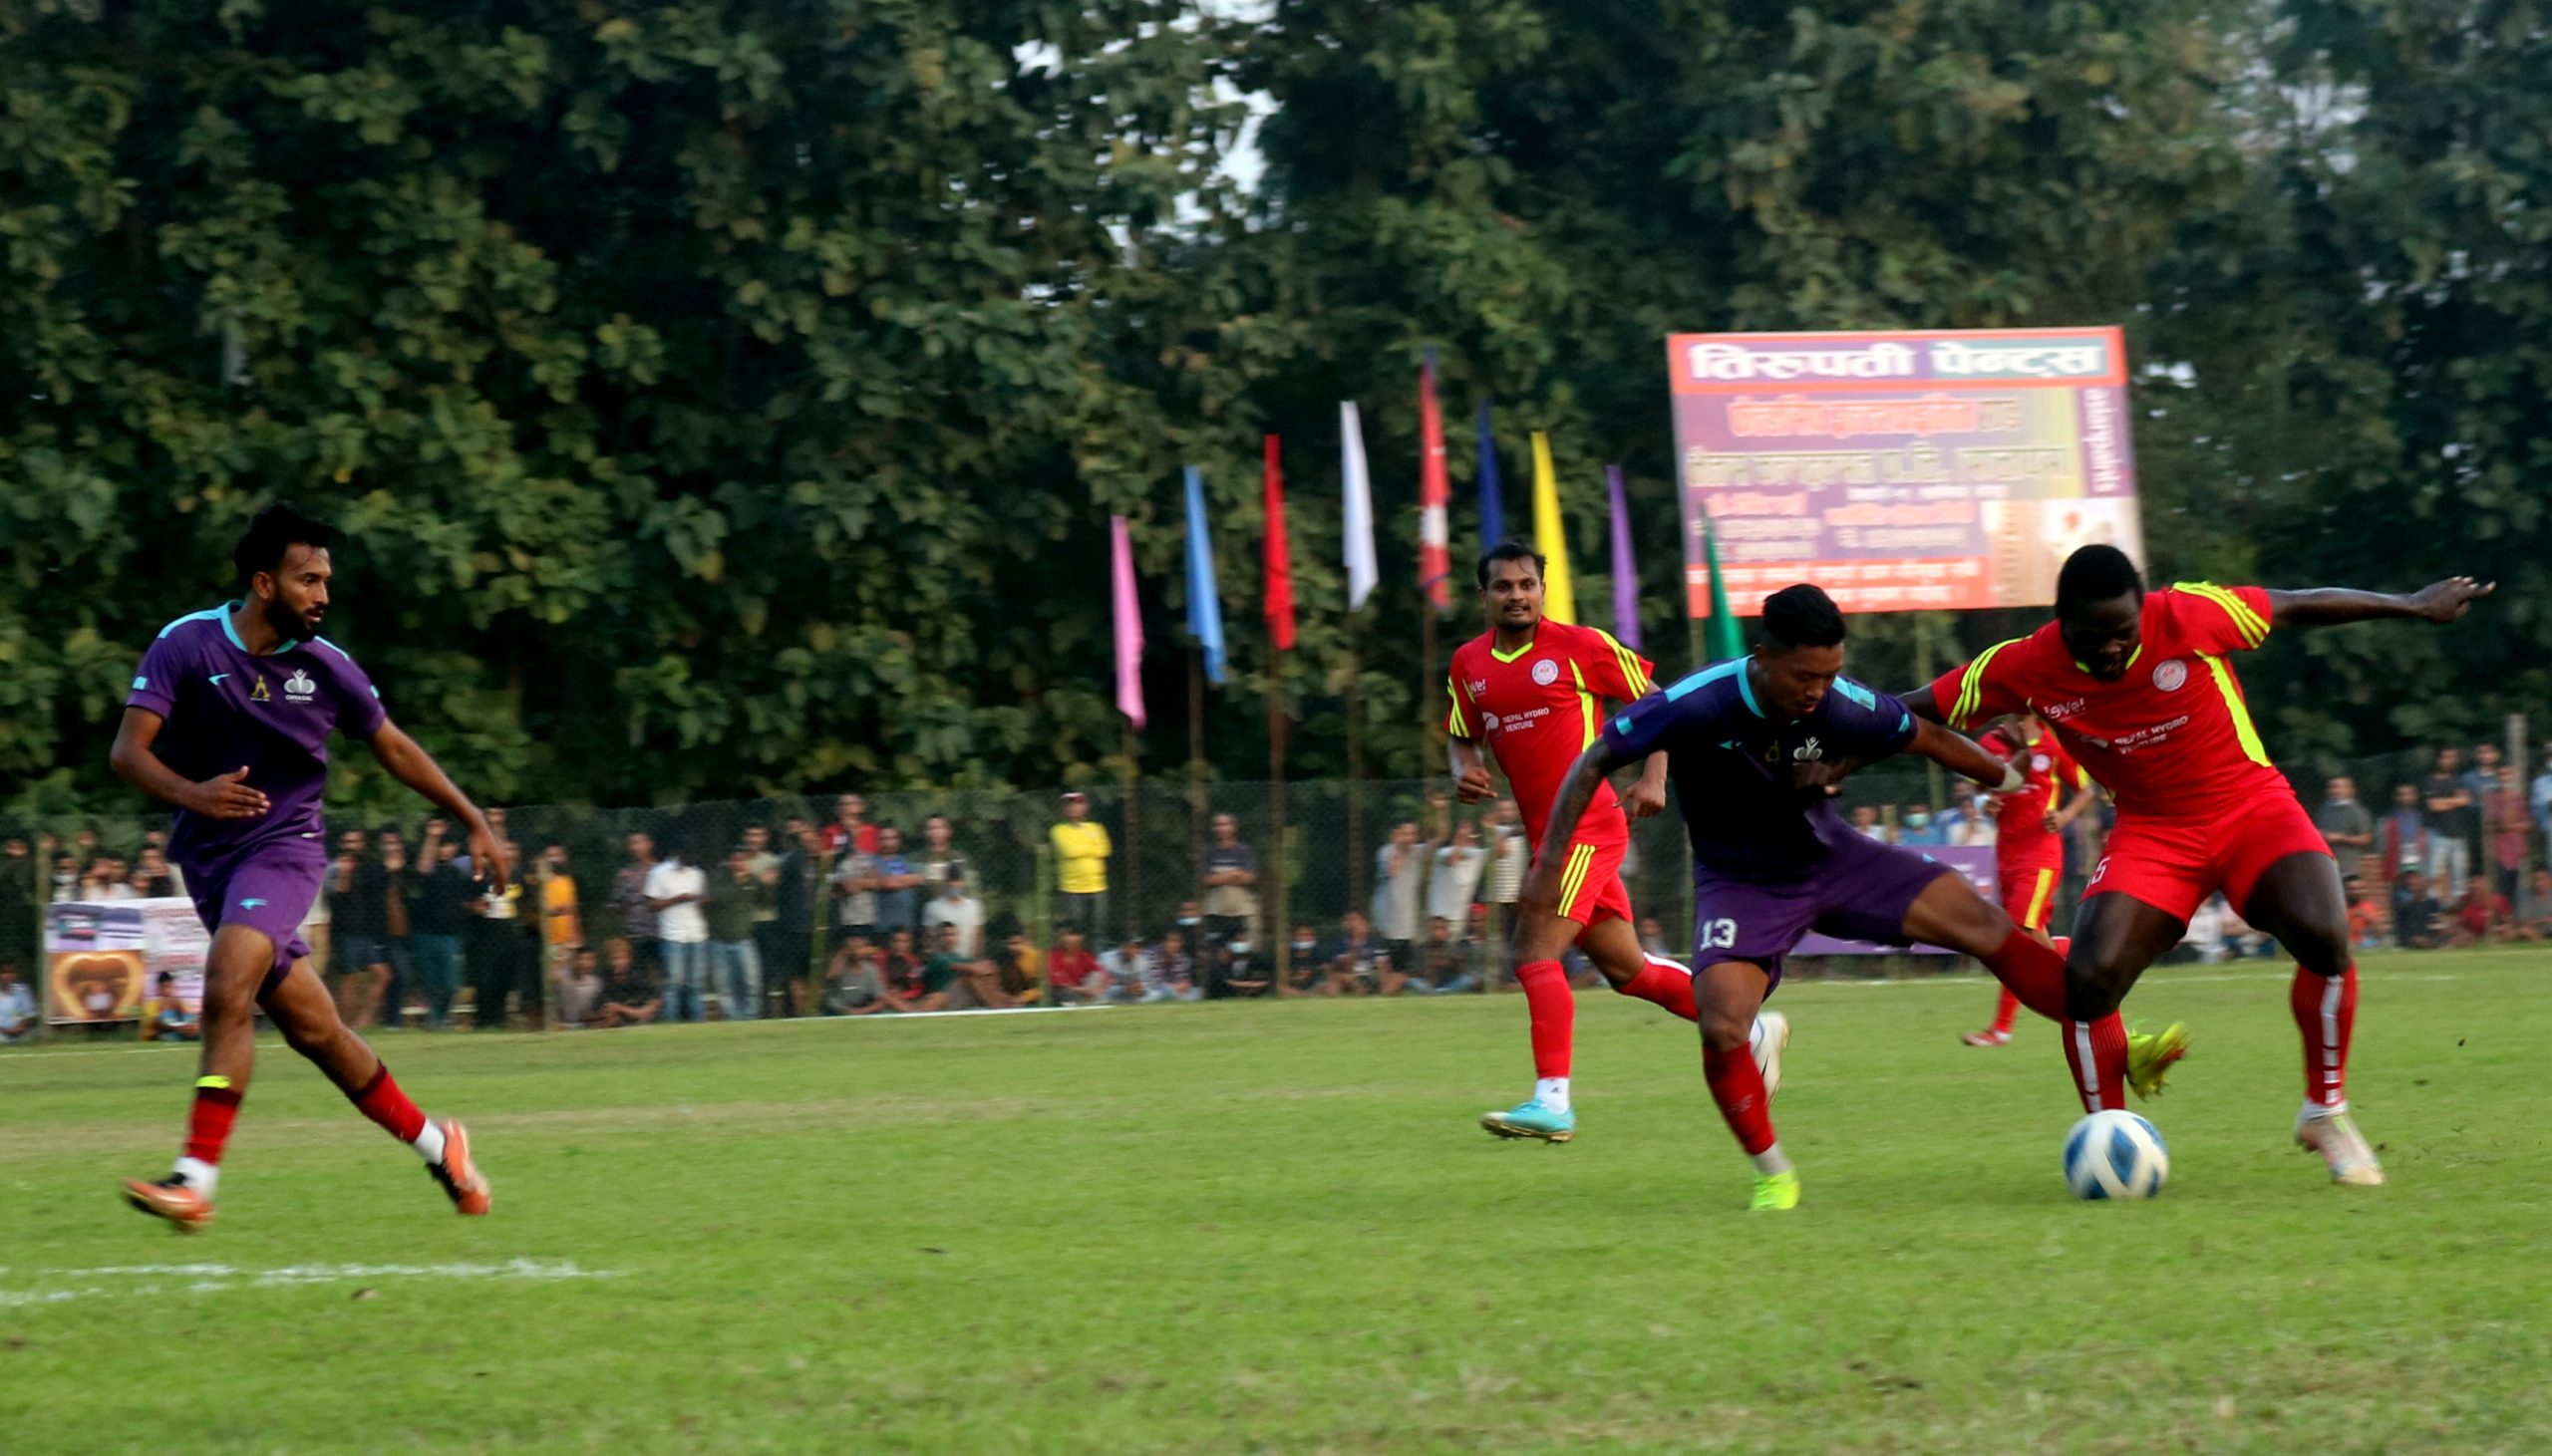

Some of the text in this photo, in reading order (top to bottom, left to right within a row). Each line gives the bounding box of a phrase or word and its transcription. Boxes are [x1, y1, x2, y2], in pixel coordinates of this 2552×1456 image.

[1502, 707, 1550, 724] NEPAL HYDRO
[1504, 720, 1534, 732] VENTURE
[2150, 715, 2189, 735] HYDRO
[1700, 917, 1738, 953] 13
